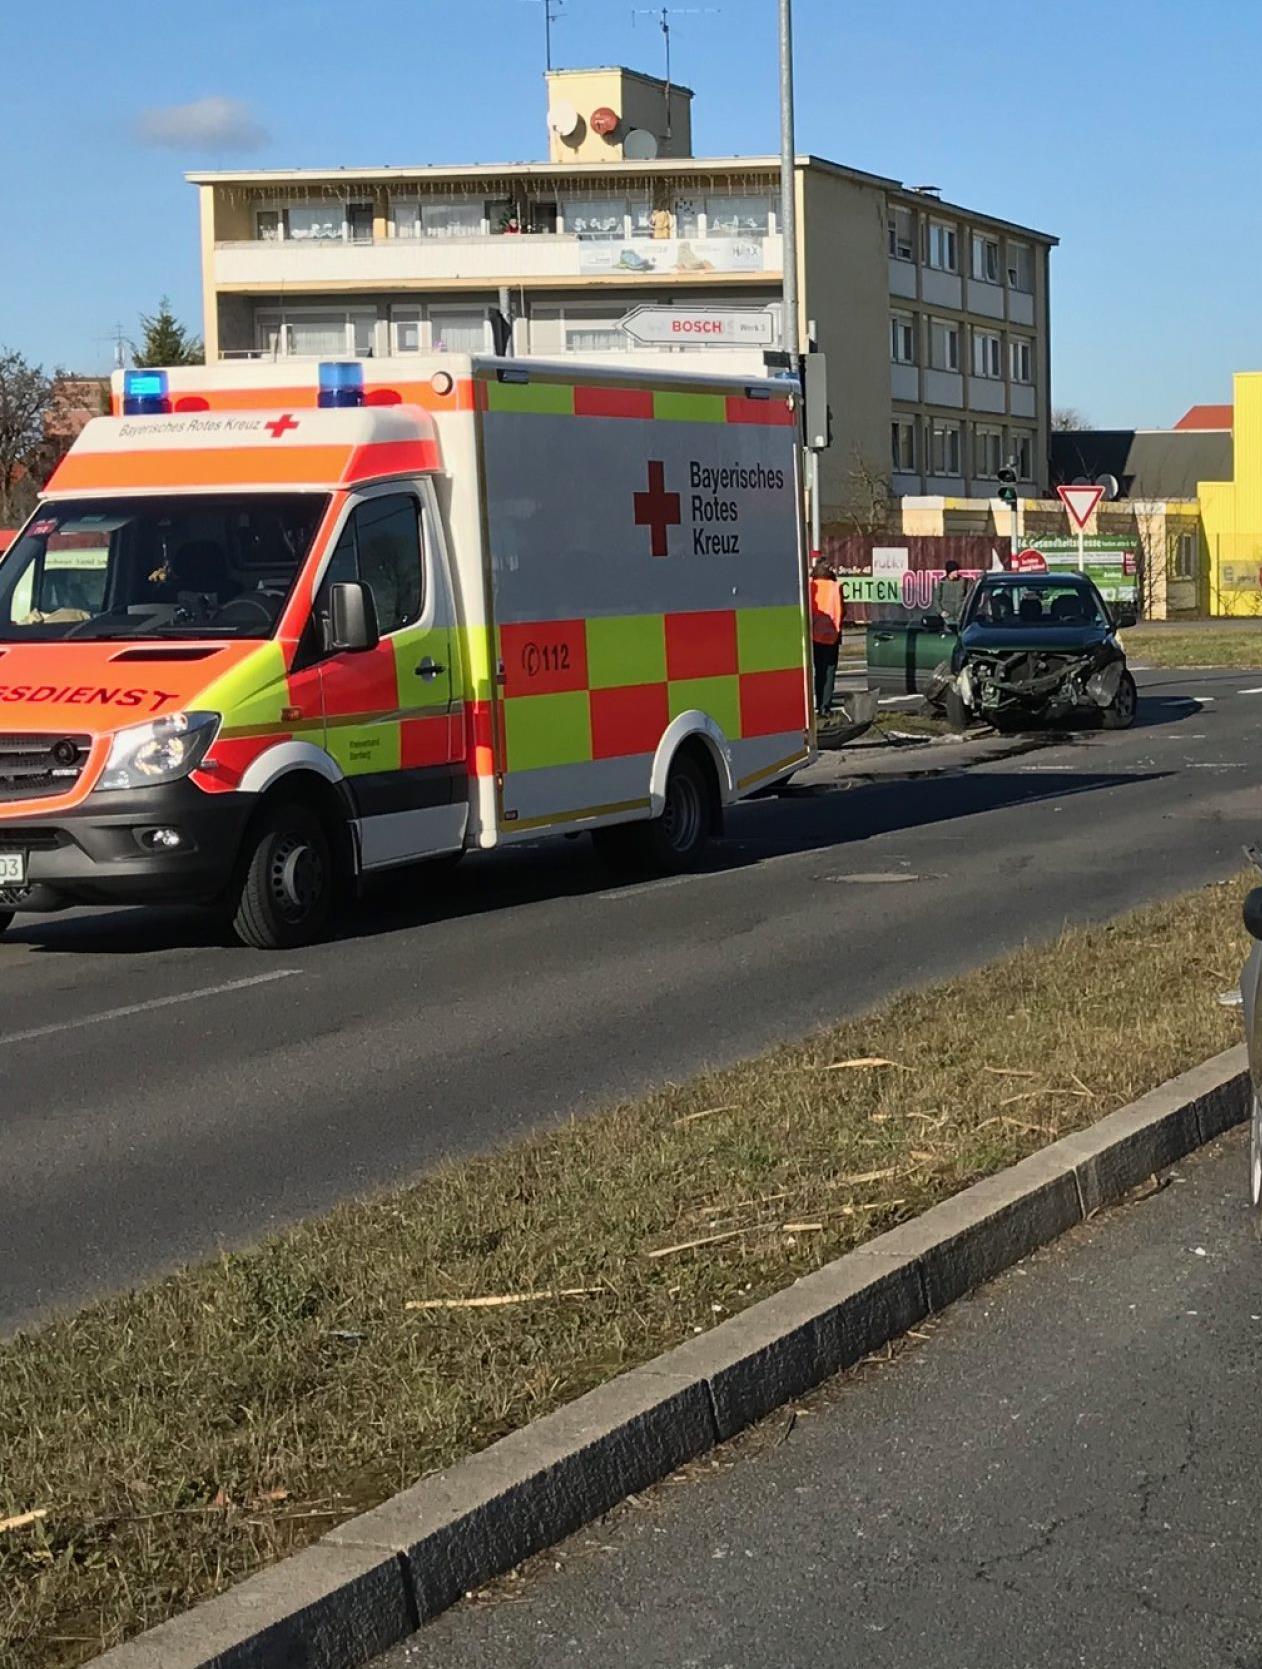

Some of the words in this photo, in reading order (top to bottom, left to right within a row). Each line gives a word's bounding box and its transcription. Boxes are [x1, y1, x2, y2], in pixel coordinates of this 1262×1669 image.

[671, 320, 723, 334] BOSCH
[118, 419, 185, 440] Bayerisches
[186, 418, 222, 433] Rotes
[225, 417, 263, 431] Kreuz
[689, 460, 784, 495] Bayerisches
[691, 495, 739, 522] Rotes
[692, 527, 740, 556] Kreuz
[542, 642, 571, 672] 112
